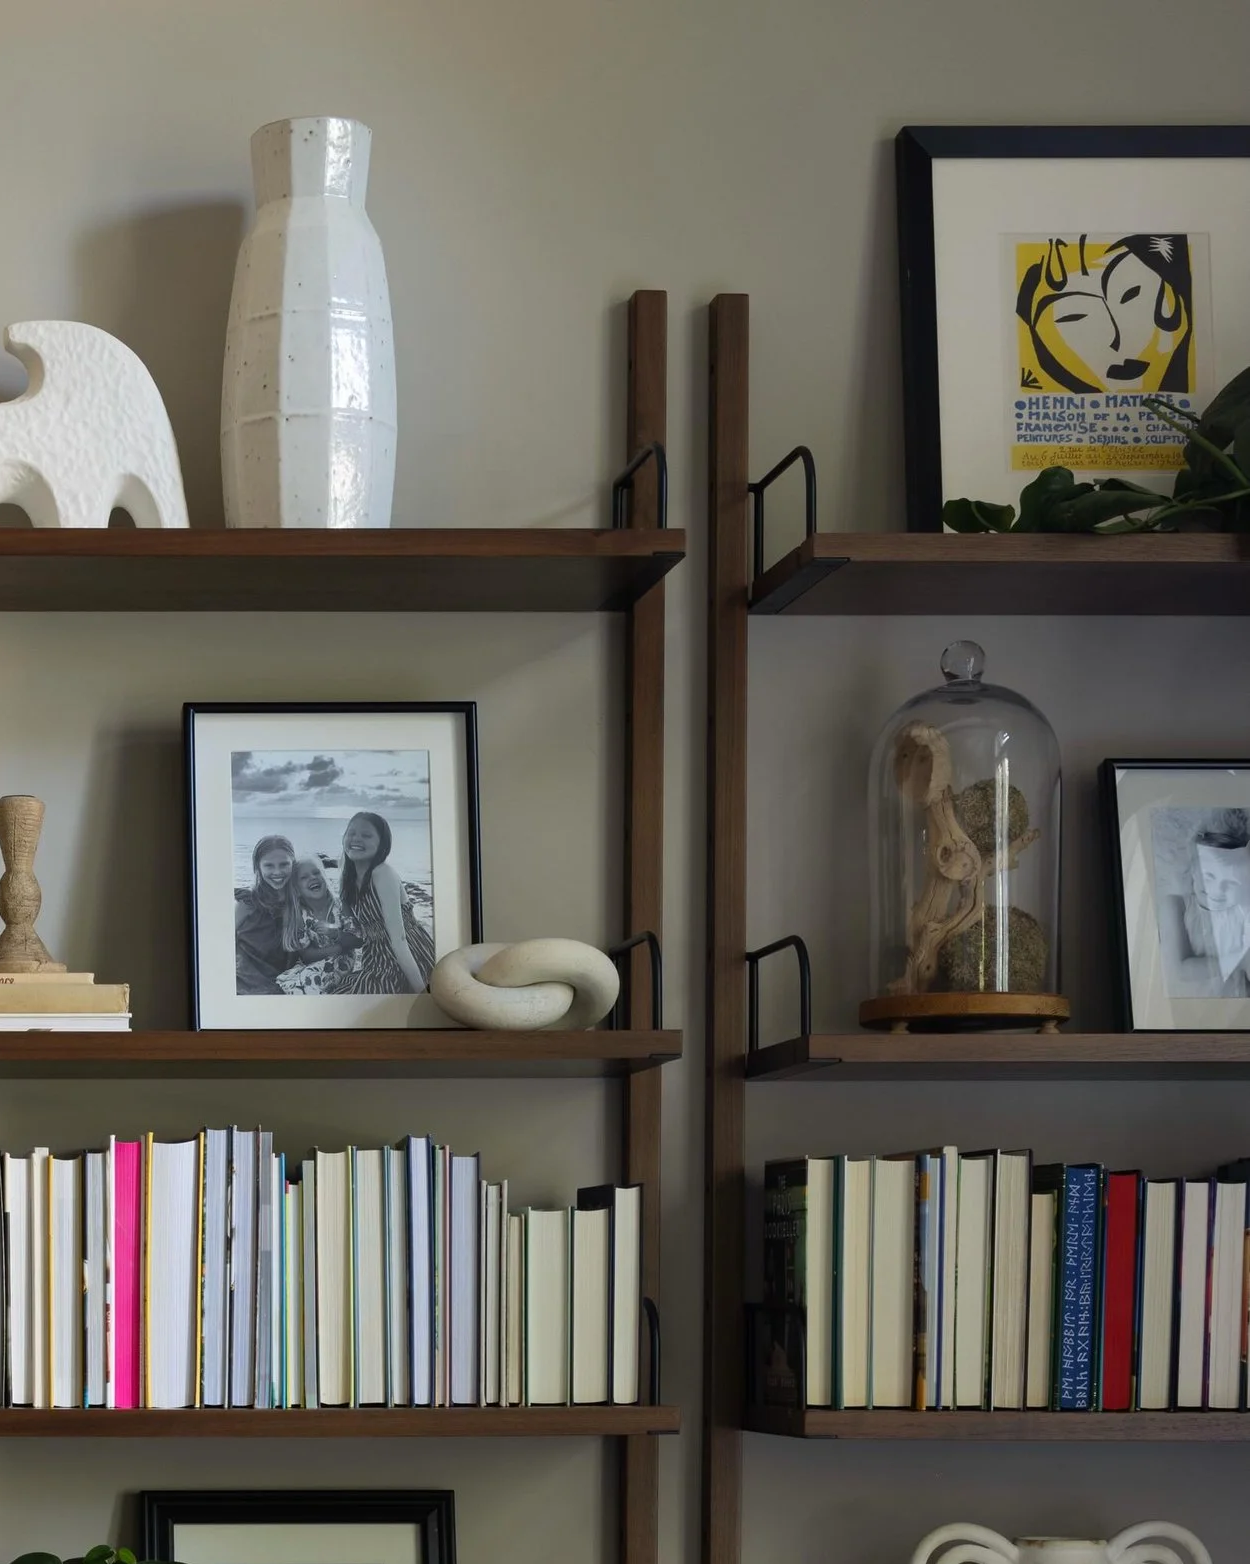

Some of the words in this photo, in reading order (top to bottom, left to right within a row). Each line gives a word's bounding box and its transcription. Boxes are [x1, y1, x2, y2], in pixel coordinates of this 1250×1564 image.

[1028, 396, 1085, 410] HENRI
[1028, 410, 1086, 422] MAISON
[1093, 413, 1110, 421] DE
[1116, 412, 1130, 422] LA
[1016, 434, 1073, 443] PEINTURES
